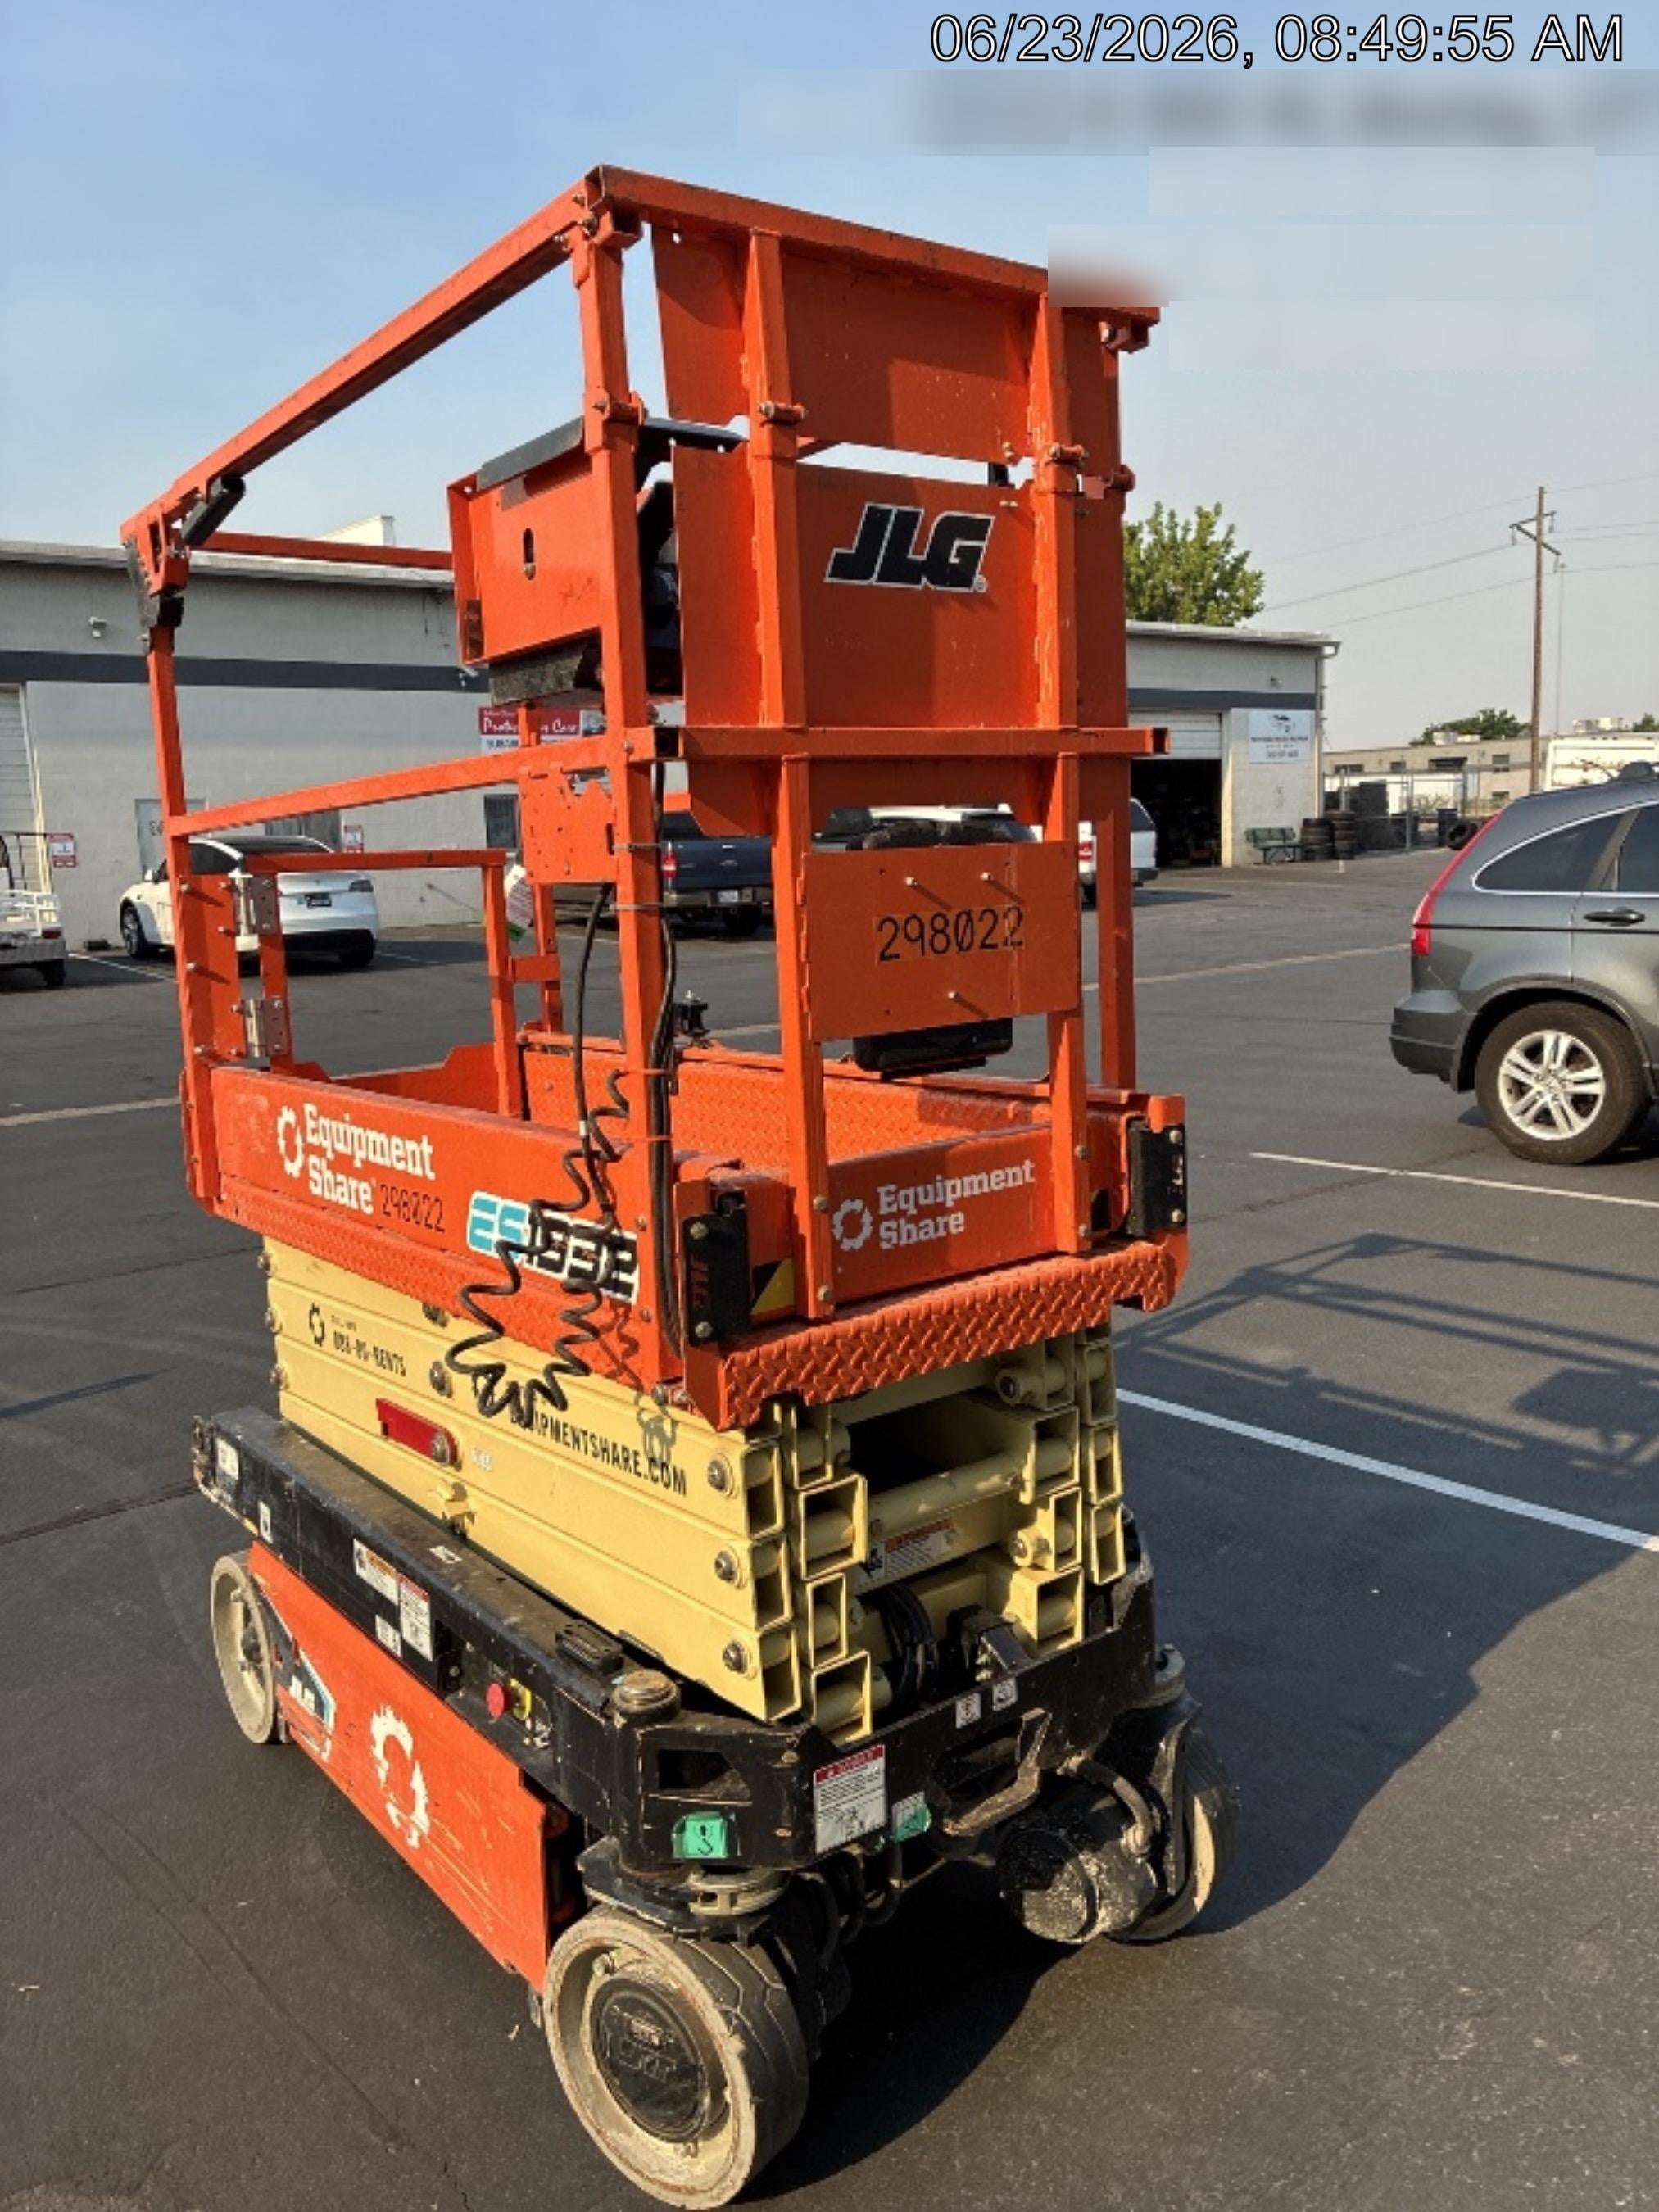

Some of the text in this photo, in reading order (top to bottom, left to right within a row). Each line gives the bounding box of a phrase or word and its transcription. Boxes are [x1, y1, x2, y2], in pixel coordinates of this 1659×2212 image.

[823, 501, 995, 592] JLG
[877, 906, 1022, 962] 298022
[304, 1103, 436, 1180] Equipment
[307, 1154, 446, 1233] Share 298022
[877, 1159, 1036, 1215] Equipment
[879, 1211, 965, 1249] Share
[510, 1403, 687, 1496] IPMENTSHARE.COM
